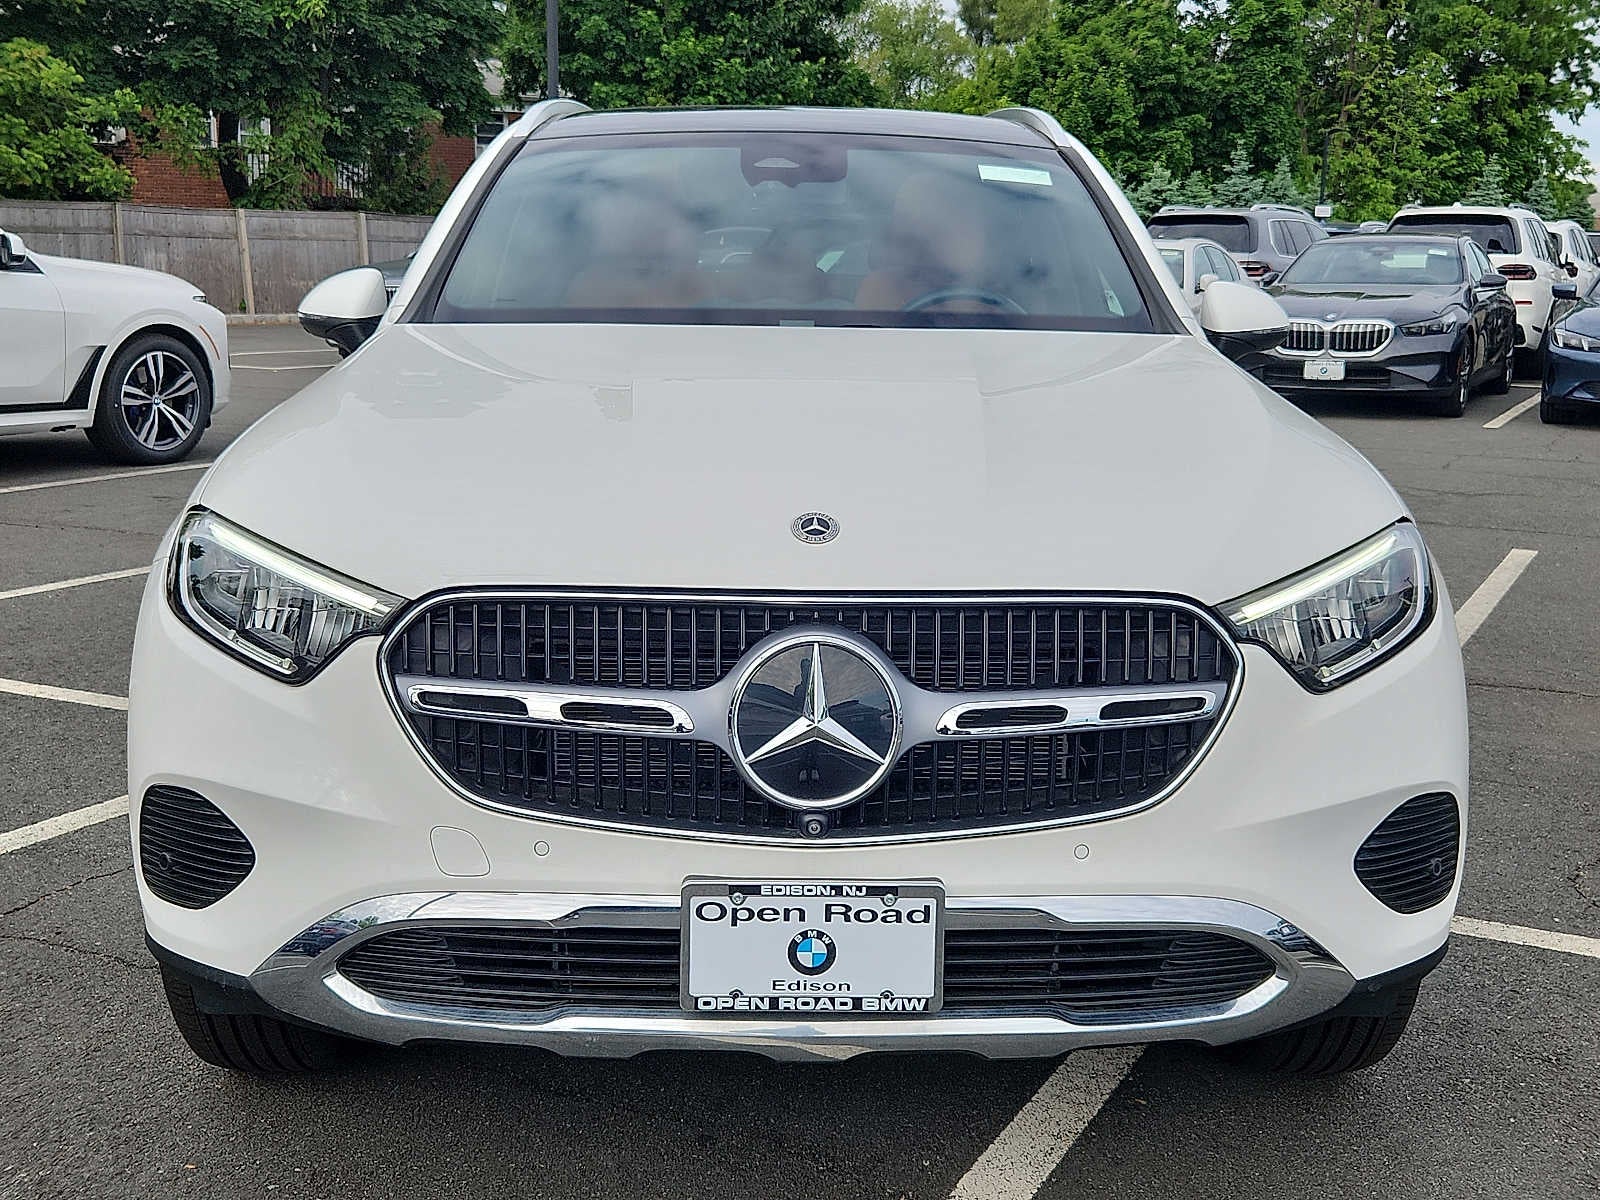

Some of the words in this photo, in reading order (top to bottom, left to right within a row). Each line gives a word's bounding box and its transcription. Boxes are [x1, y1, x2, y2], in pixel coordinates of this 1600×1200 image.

[760, 885, 836, 896] EDISON,
[844, 886, 867, 896] NJ
[695, 901, 806, 926] Open
[825, 904, 931, 923] Road
[793, 930, 832, 944] BMW
[772, 980, 851, 991] Edison
[697, 998, 769, 1010] OPEN
[779, 998, 852, 1010] ROAD
[862, 998, 926, 1011] BMW
